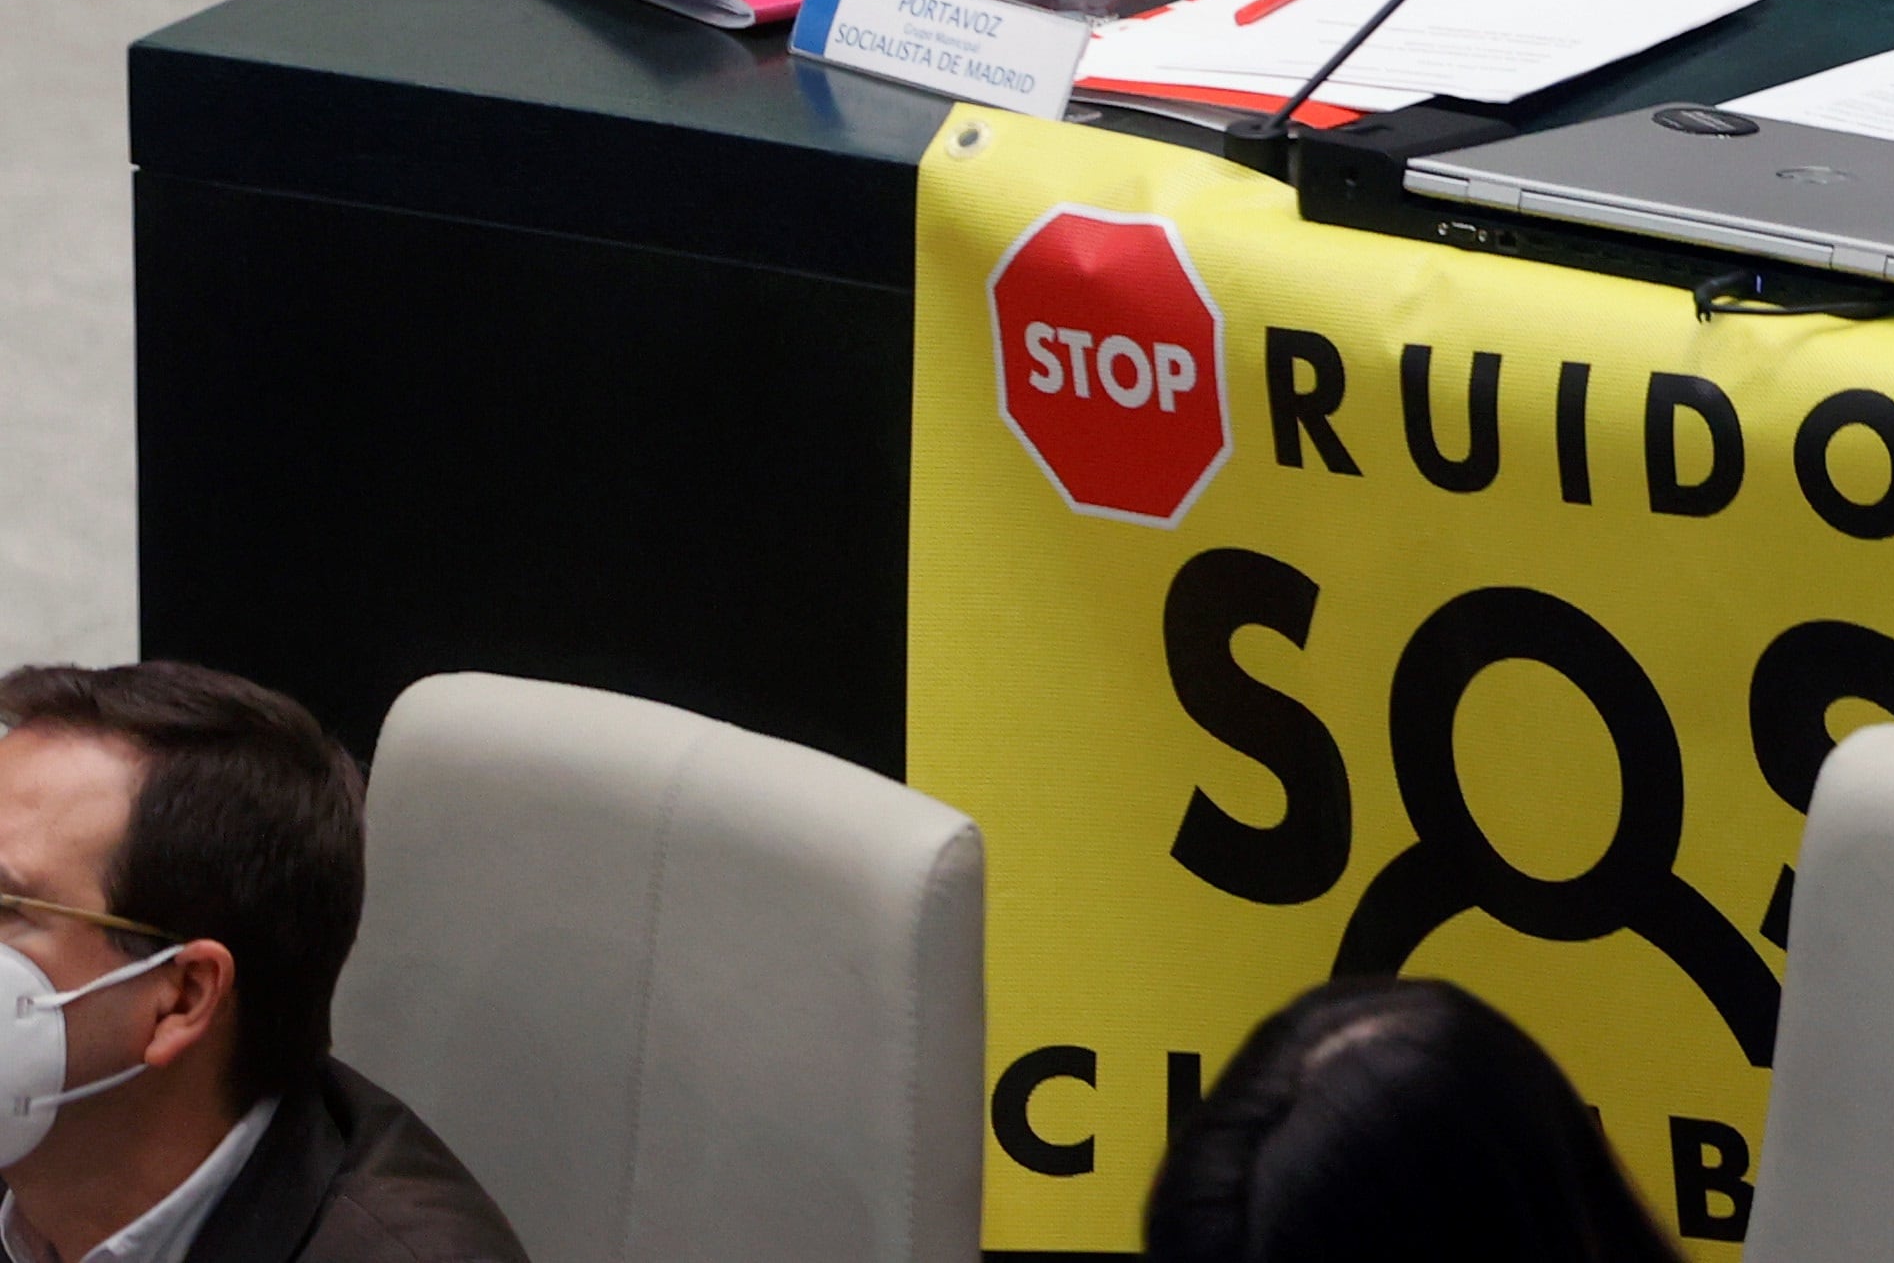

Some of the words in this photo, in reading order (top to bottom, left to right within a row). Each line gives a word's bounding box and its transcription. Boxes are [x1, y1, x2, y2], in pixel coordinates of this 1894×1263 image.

[834, 22, 932, 69] SOCIALISTA
[936, 50, 961, 76] DE
[965, 60, 1036, 95] MADRID
[1024, 320, 1197, 413] STOP
